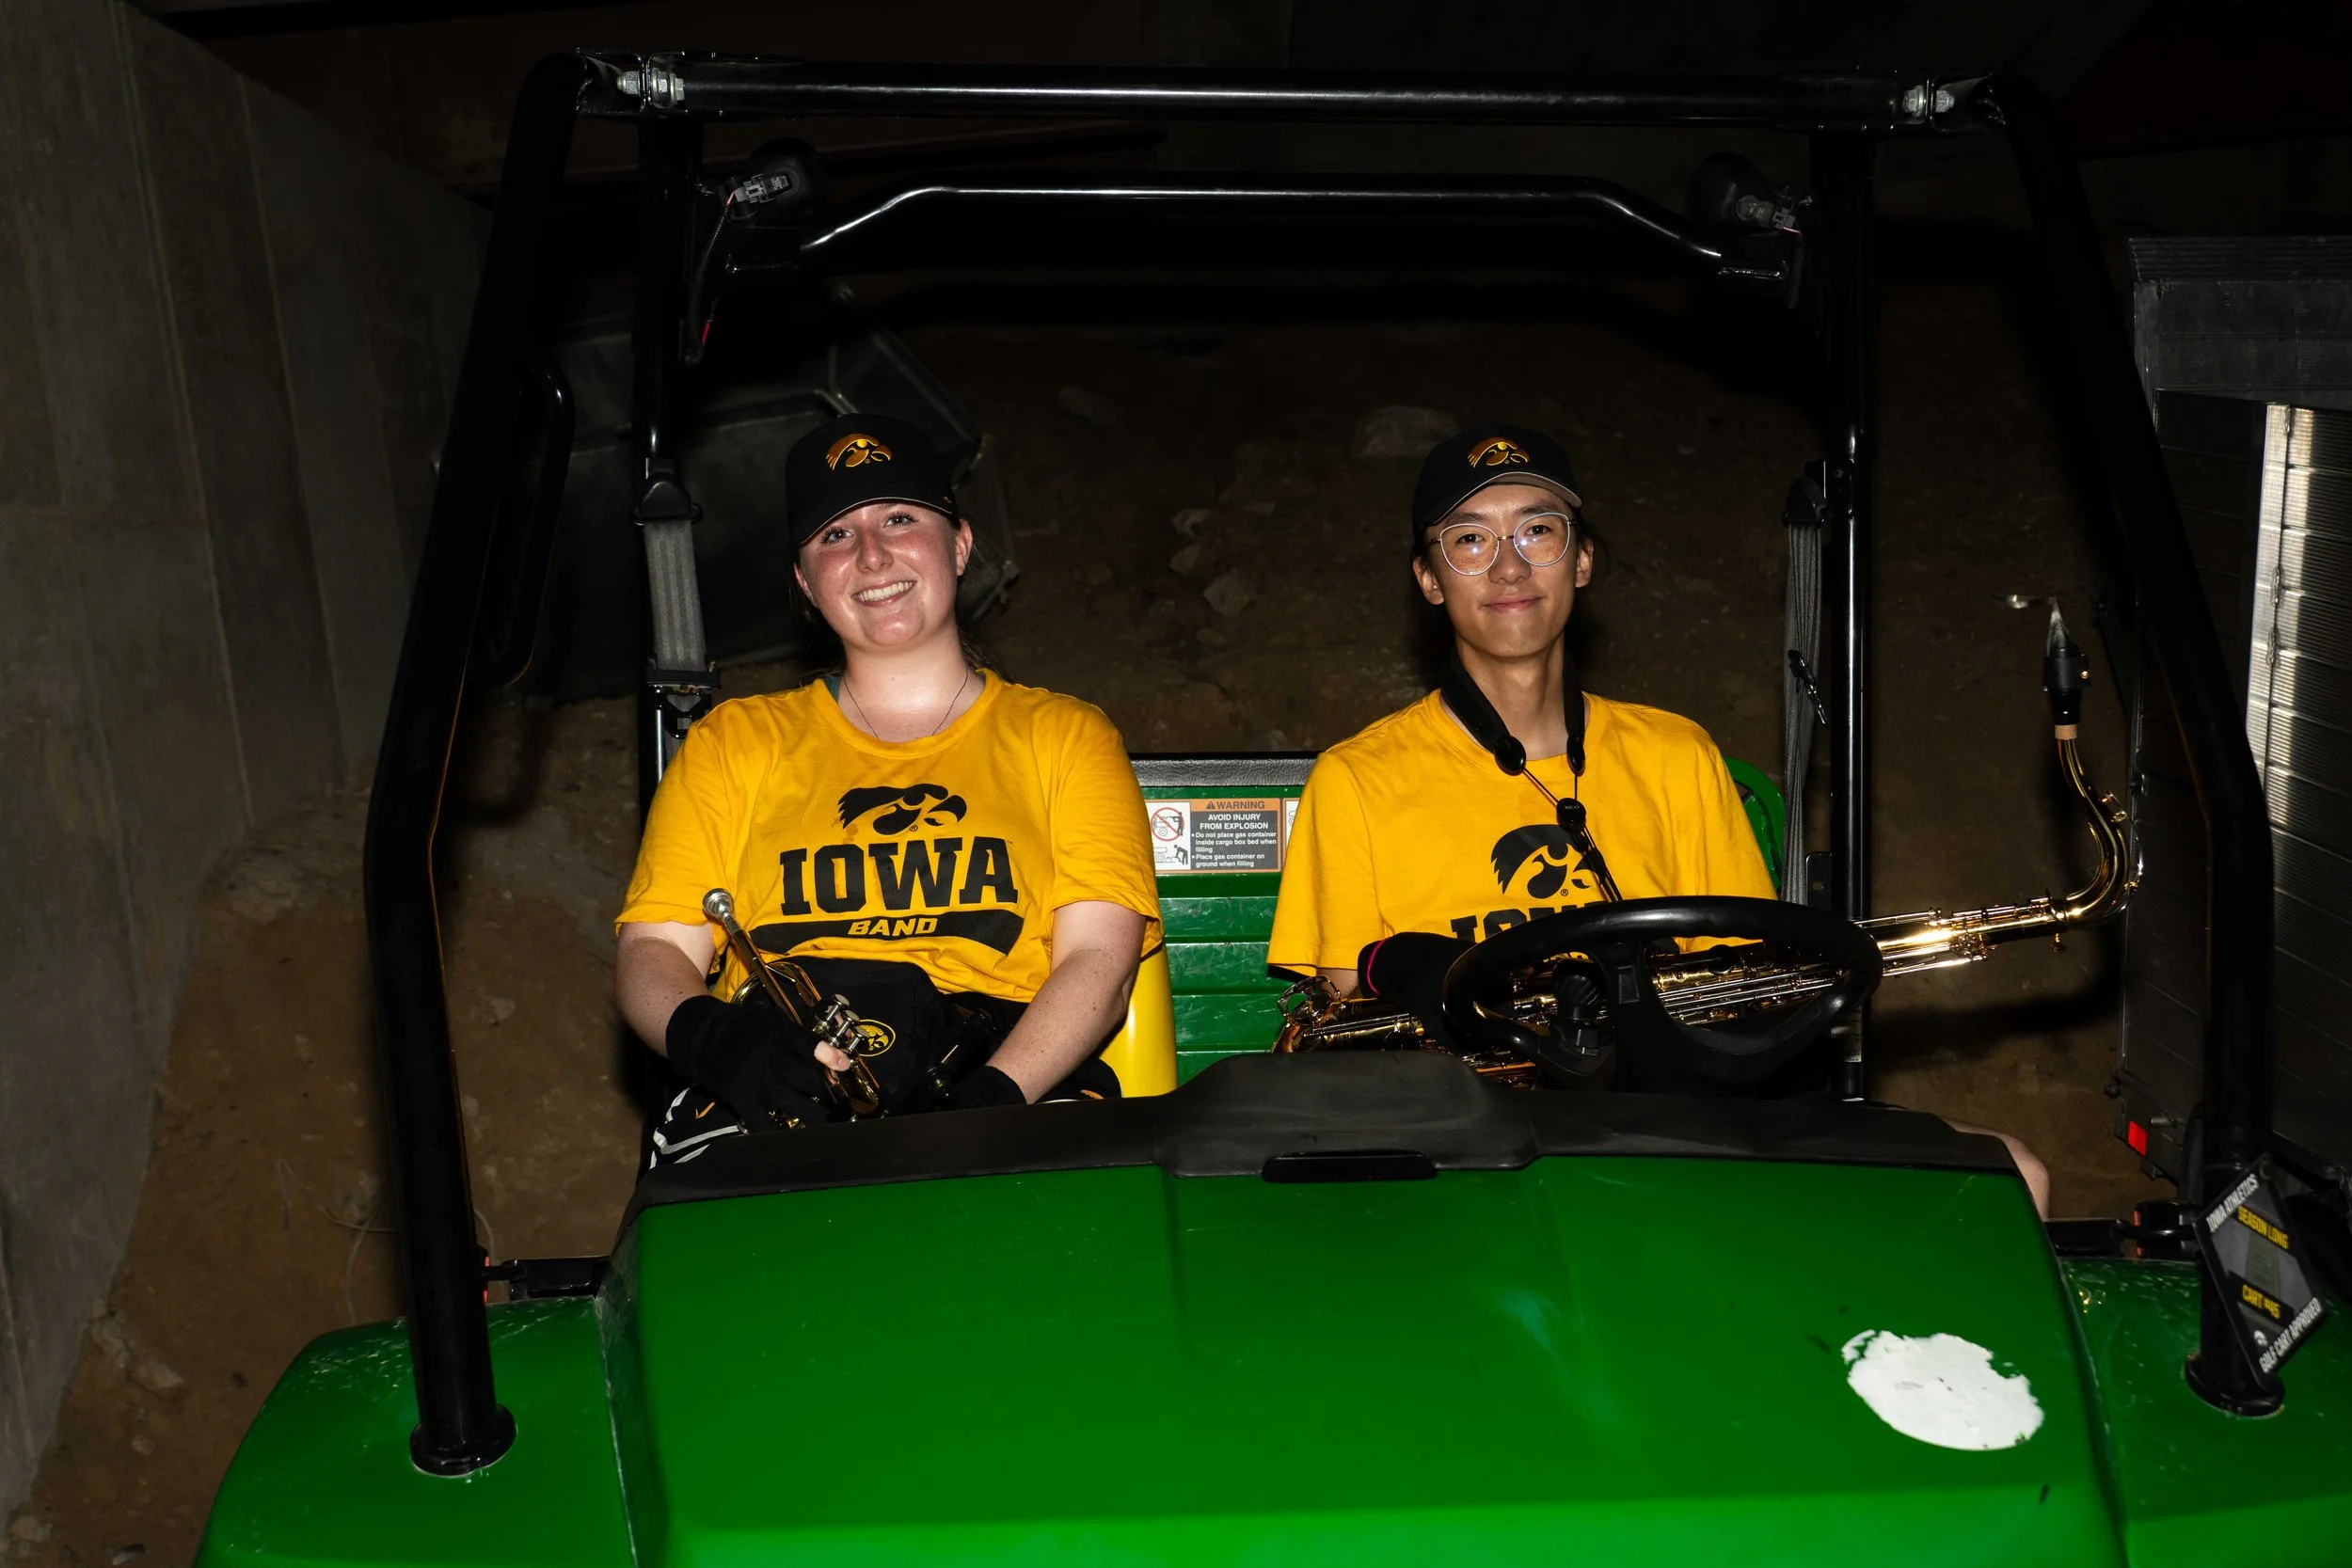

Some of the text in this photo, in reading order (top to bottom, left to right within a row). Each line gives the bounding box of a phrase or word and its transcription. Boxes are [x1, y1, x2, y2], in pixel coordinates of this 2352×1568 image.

[779, 836, 1019, 916] IOWA
[847, 918, 938, 937] BAND
[2205, 1173, 2259, 1233] IOWA ATHLETICS
[2237, 1205, 2290, 1250] SEASON LONG
[2242, 1284, 2264, 1310] CART
[2259, 1297, 2322, 1373] GOLF CART APPROVED
